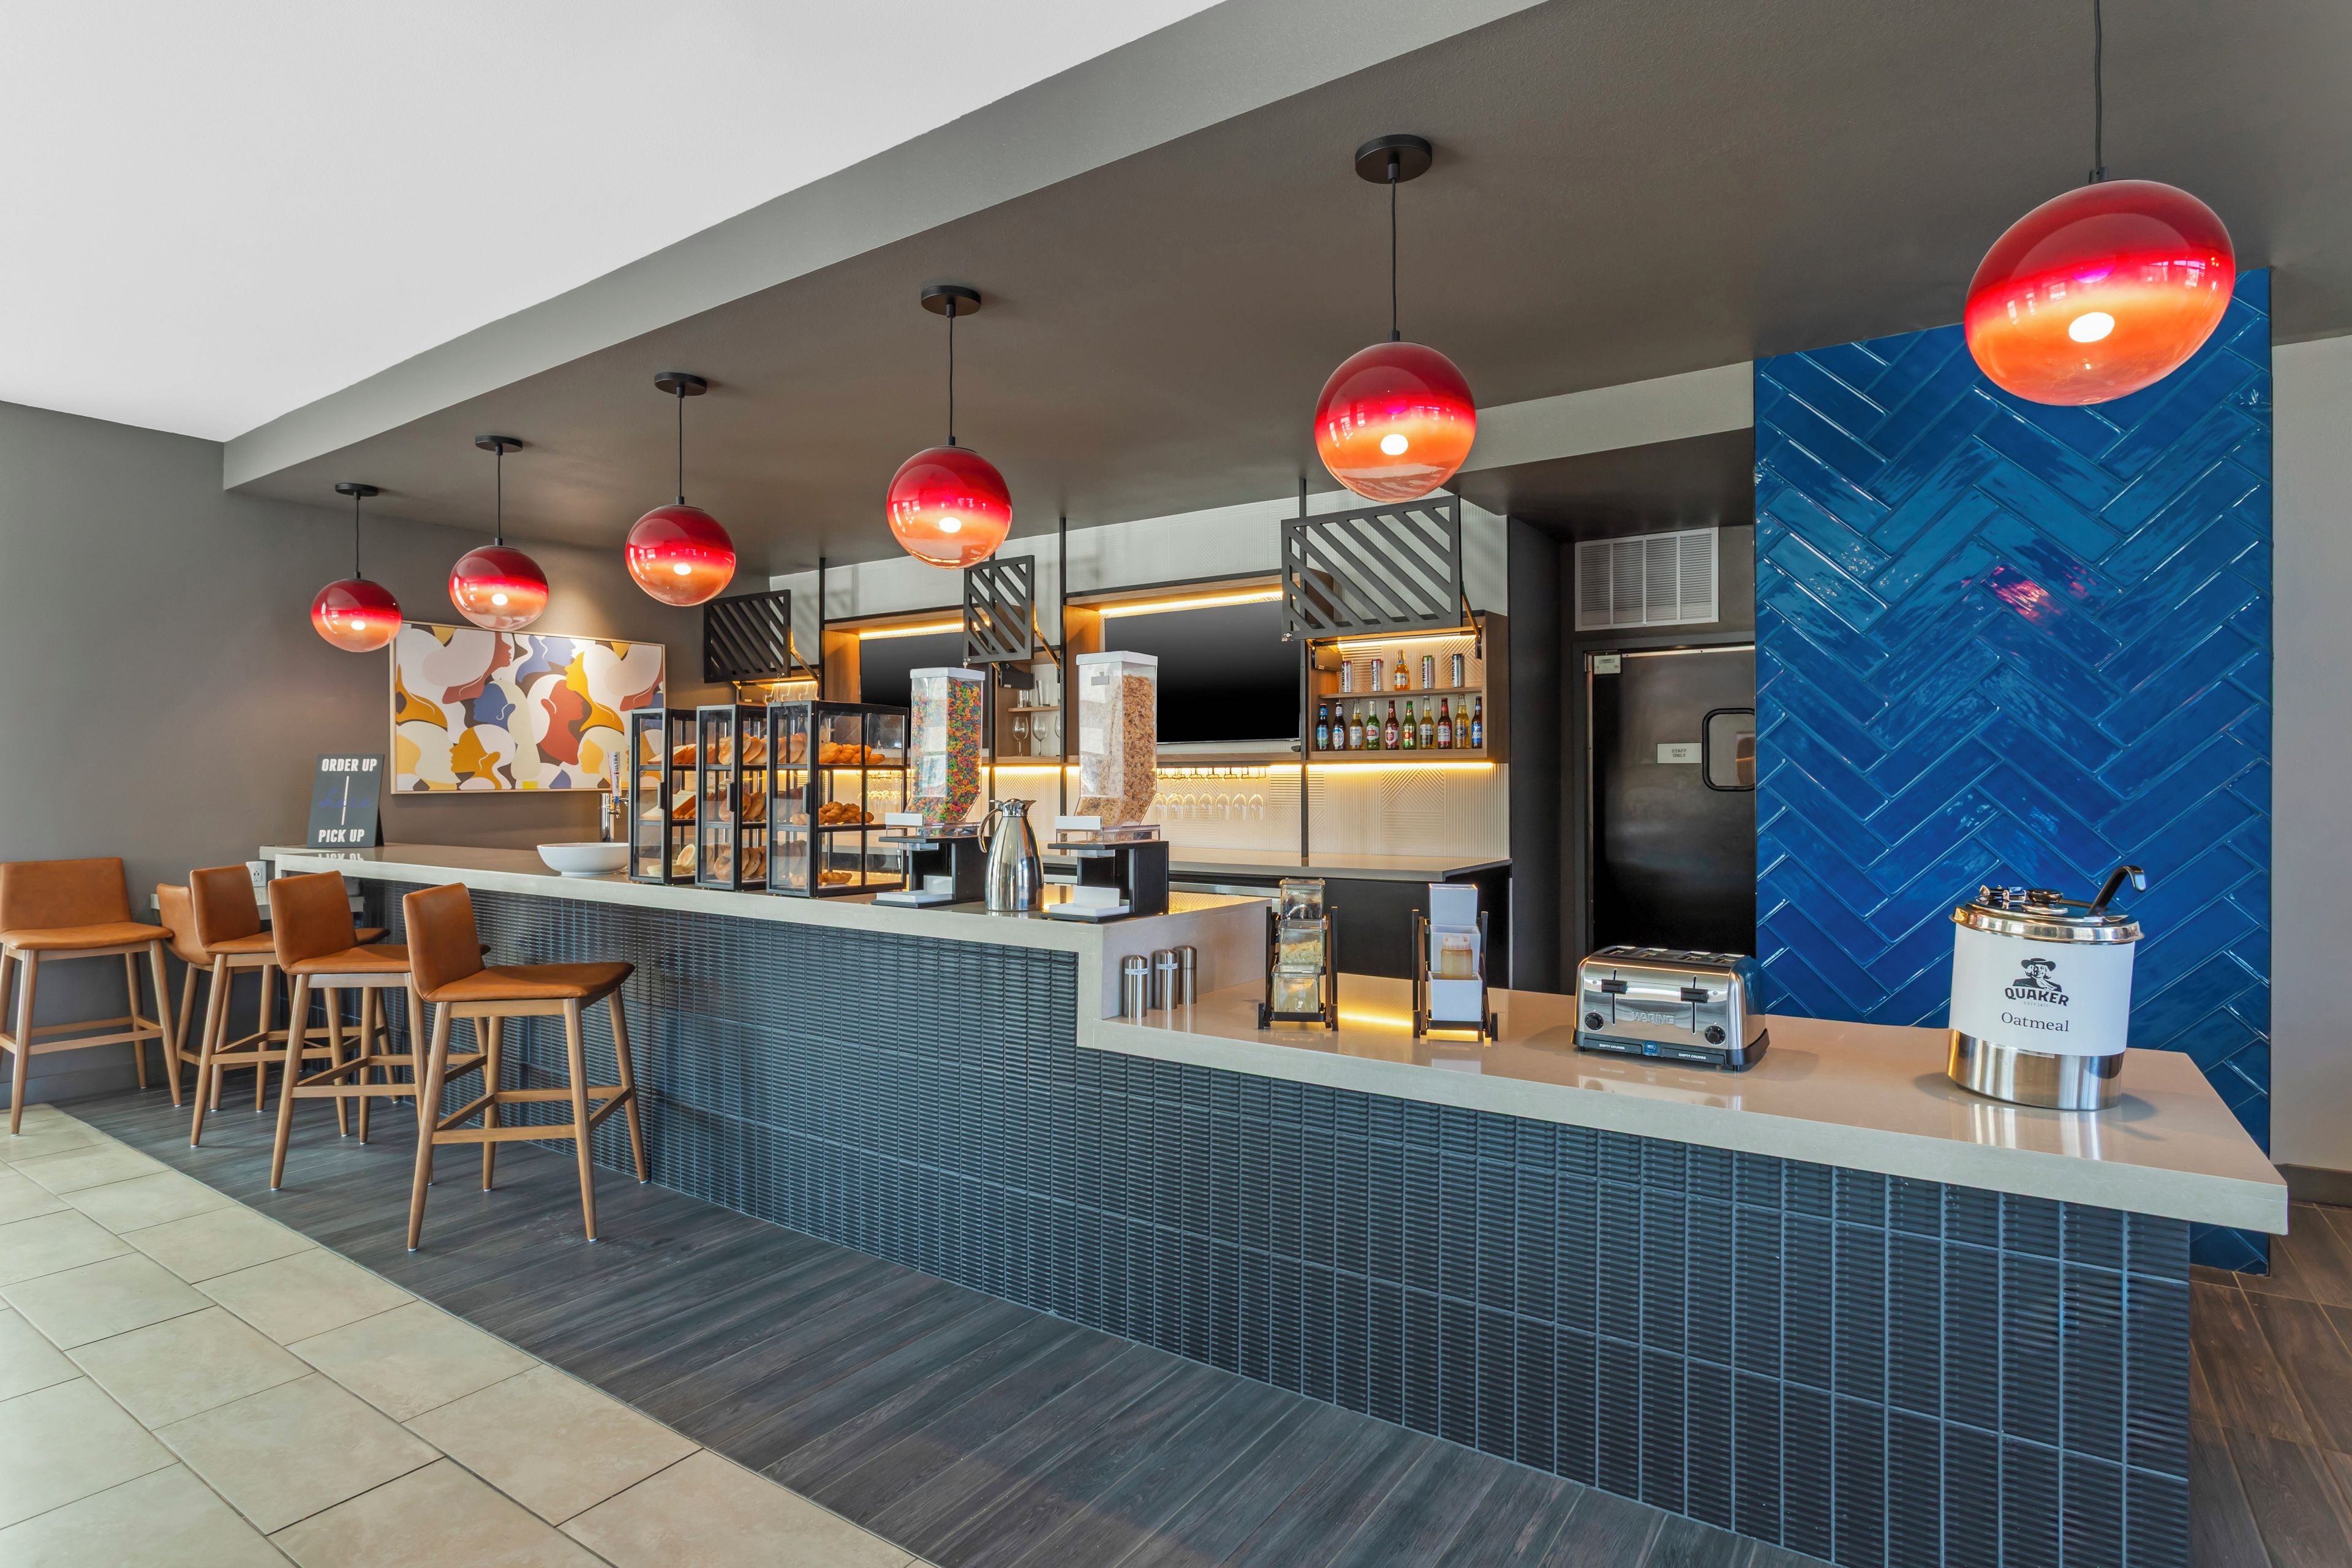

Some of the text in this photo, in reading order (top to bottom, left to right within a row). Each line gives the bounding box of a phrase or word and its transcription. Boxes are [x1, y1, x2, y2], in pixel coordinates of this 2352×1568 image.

[322, 758, 377, 772] ORDER UP
[318, 829, 365, 843] PICK UP
[2005, 987, 2069, 1006] QUAKER
[1632, 1011, 1675, 1025] WARING
[2002, 1012, 2069, 1031] Oatmeal
